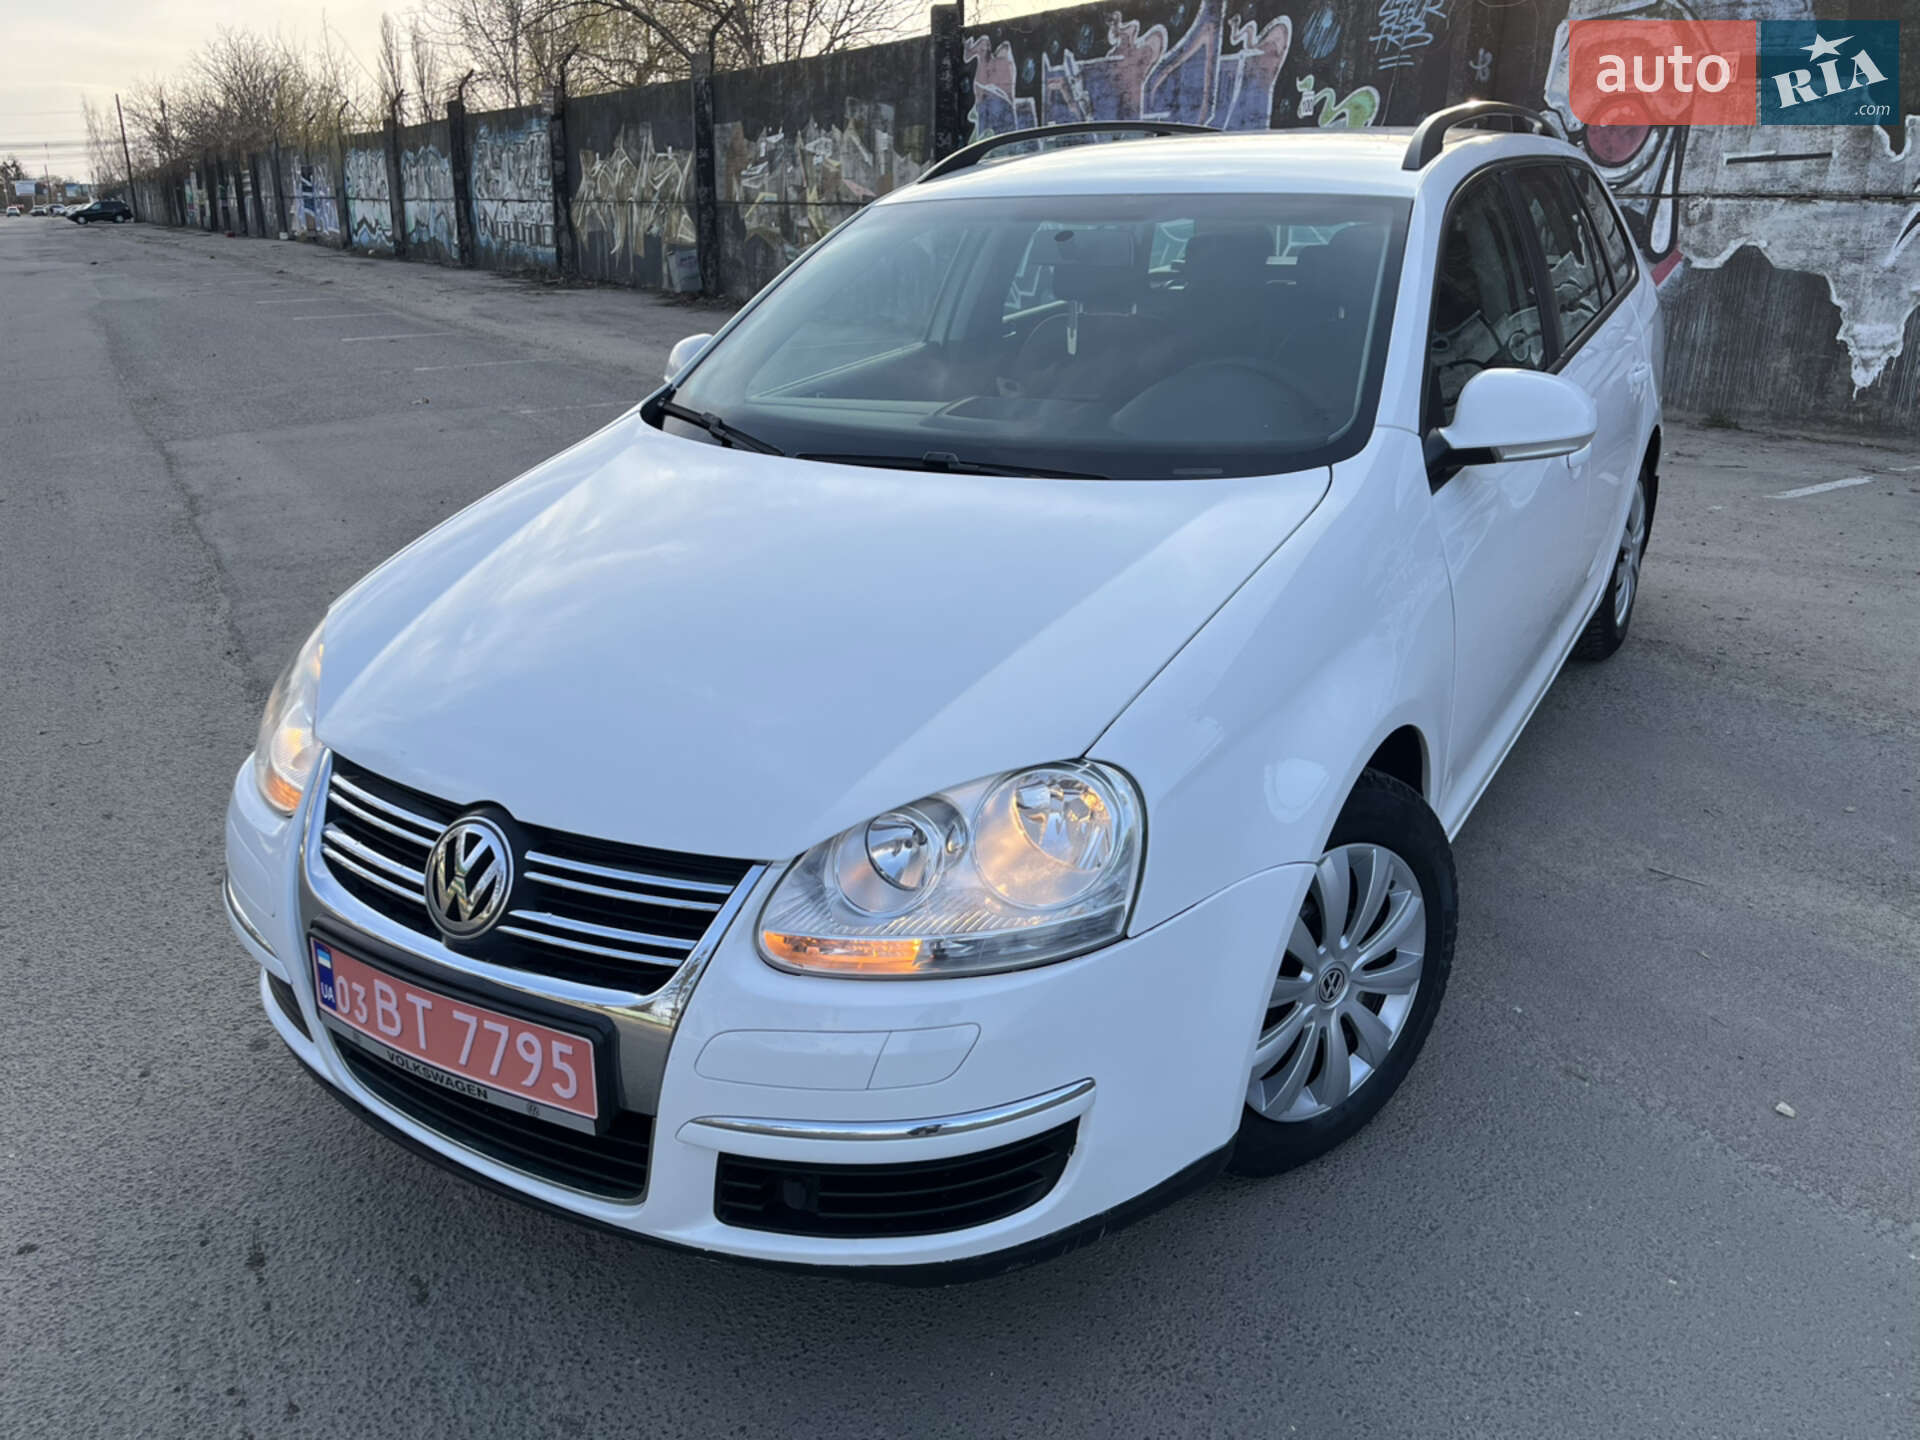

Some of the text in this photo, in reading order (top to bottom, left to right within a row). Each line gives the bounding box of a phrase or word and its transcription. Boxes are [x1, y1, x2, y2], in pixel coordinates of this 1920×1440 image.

[320, 981, 335, 1003] UA
[387, 1050, 488, 1100] VOLKSWAGEN
[453, 1011, 578, 1100] 7795
